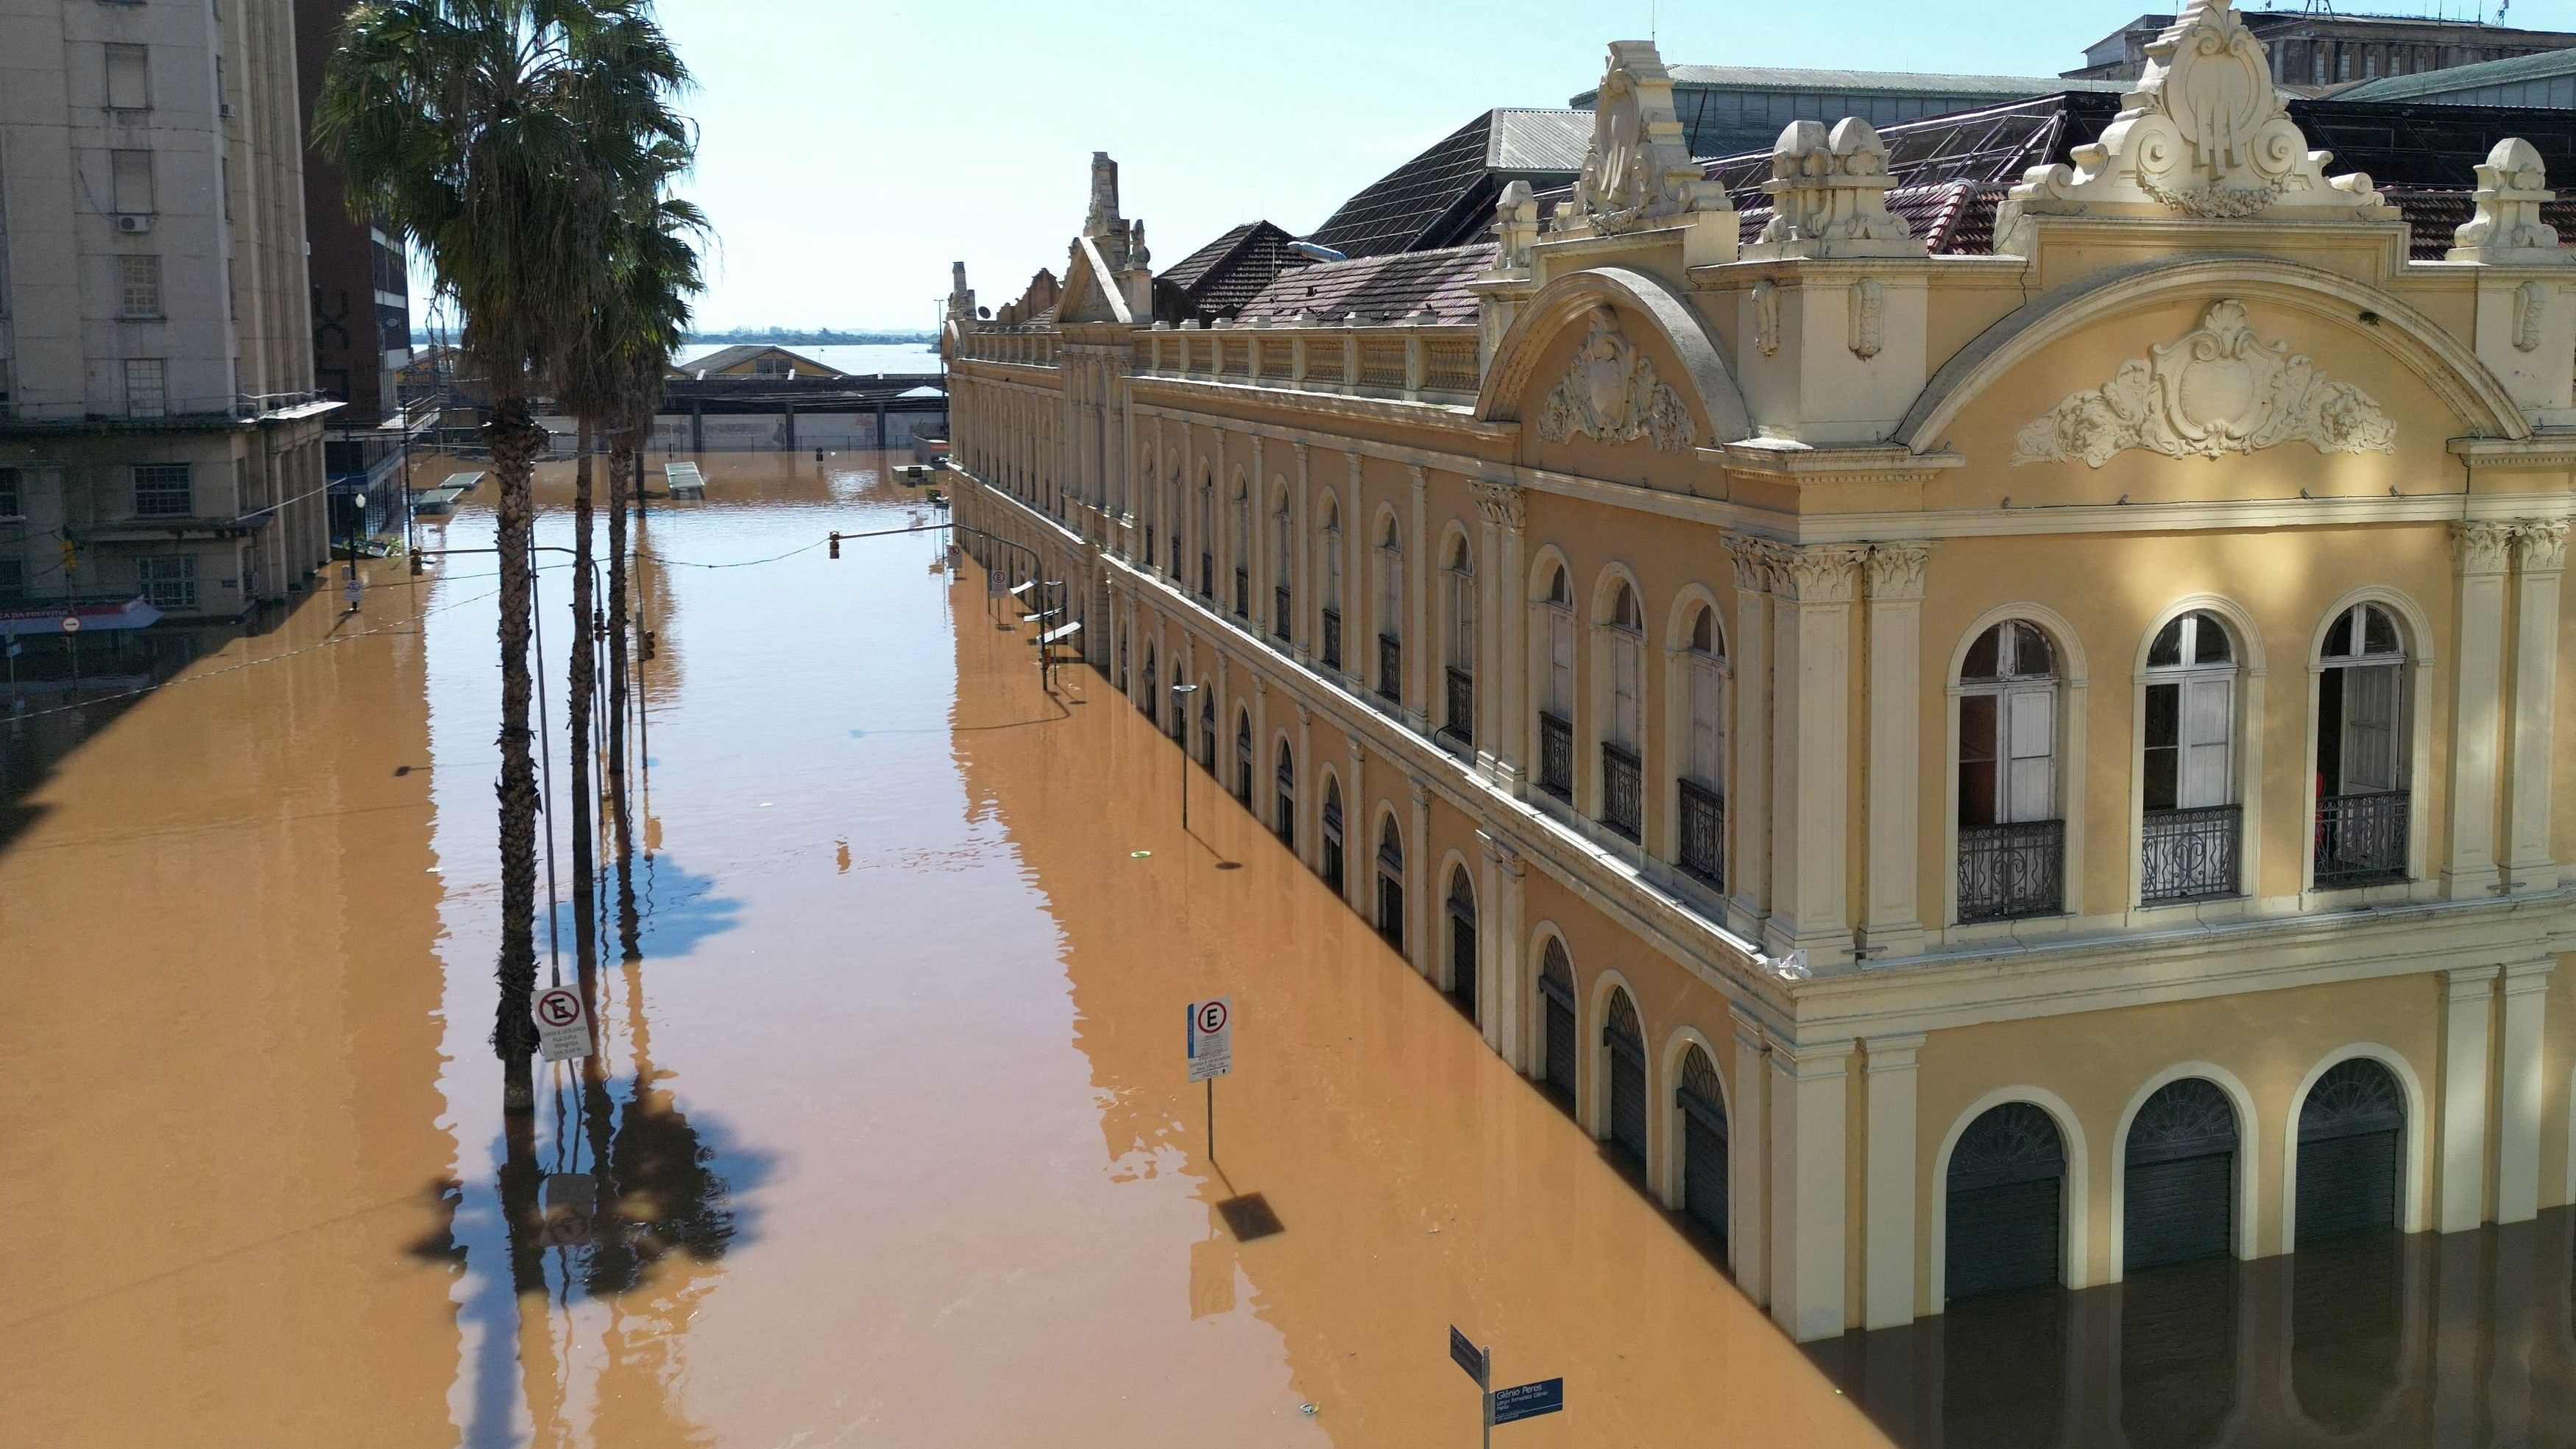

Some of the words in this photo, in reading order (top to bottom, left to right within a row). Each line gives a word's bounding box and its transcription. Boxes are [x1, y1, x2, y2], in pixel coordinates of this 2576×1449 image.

[551, 998, 567, 1019] E
[1207, 1008, 1217, 1027] E
[1496, 1388, 1520, 1400] Glênio
[1522, 1384, 1542, 1394] Peres
